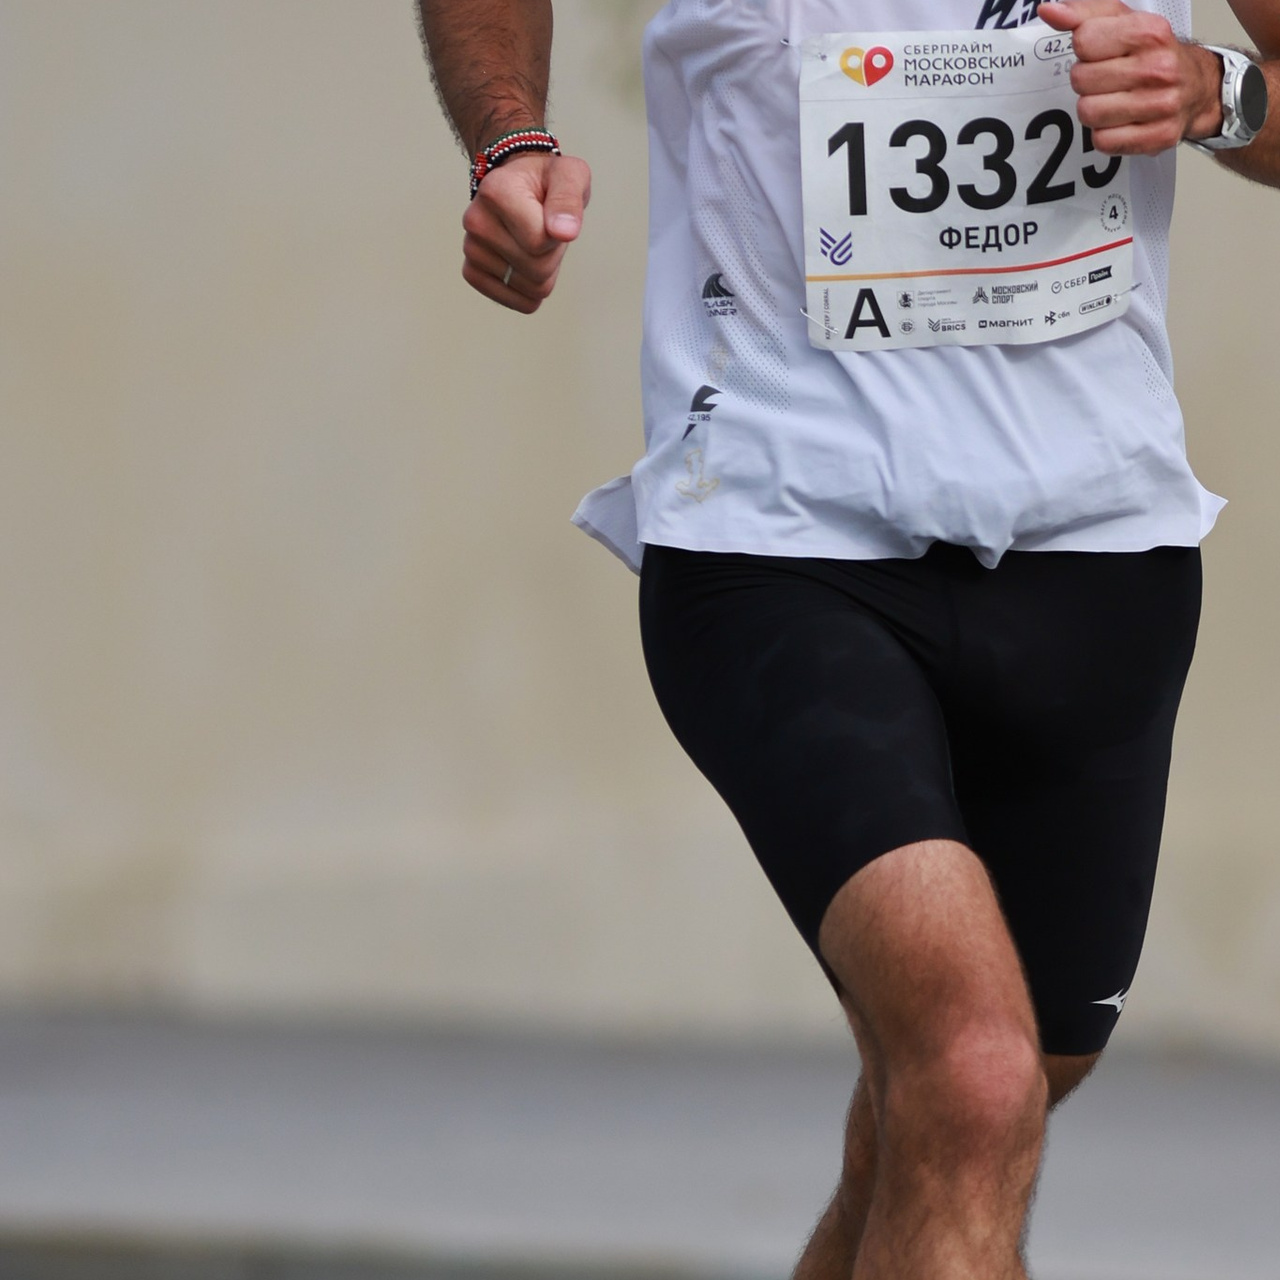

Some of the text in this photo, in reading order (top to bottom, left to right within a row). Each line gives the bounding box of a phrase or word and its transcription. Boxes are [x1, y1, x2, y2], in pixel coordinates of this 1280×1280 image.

[904, 43, 992, 55] СБЕРПРАЙМ
[904, 52, 1025, 71] МОСКОВСКИЙ
[904, 72, 994, 87] МАРАФОН
[1109, 205, 1119, 220] 4
[939, 221, 1039, 253] ФЕДОР
[992, 280, 1038, 295] МОСКОВСКИЙ
[1064, 276, 1087, 289] СБЕР
[992, 294, 1014, 304] СПОРТ
[1081, 299, 1105, 312] WINLINE
[844, 288, 892, 339] A
[941, 323, 966, 332] BRICS
